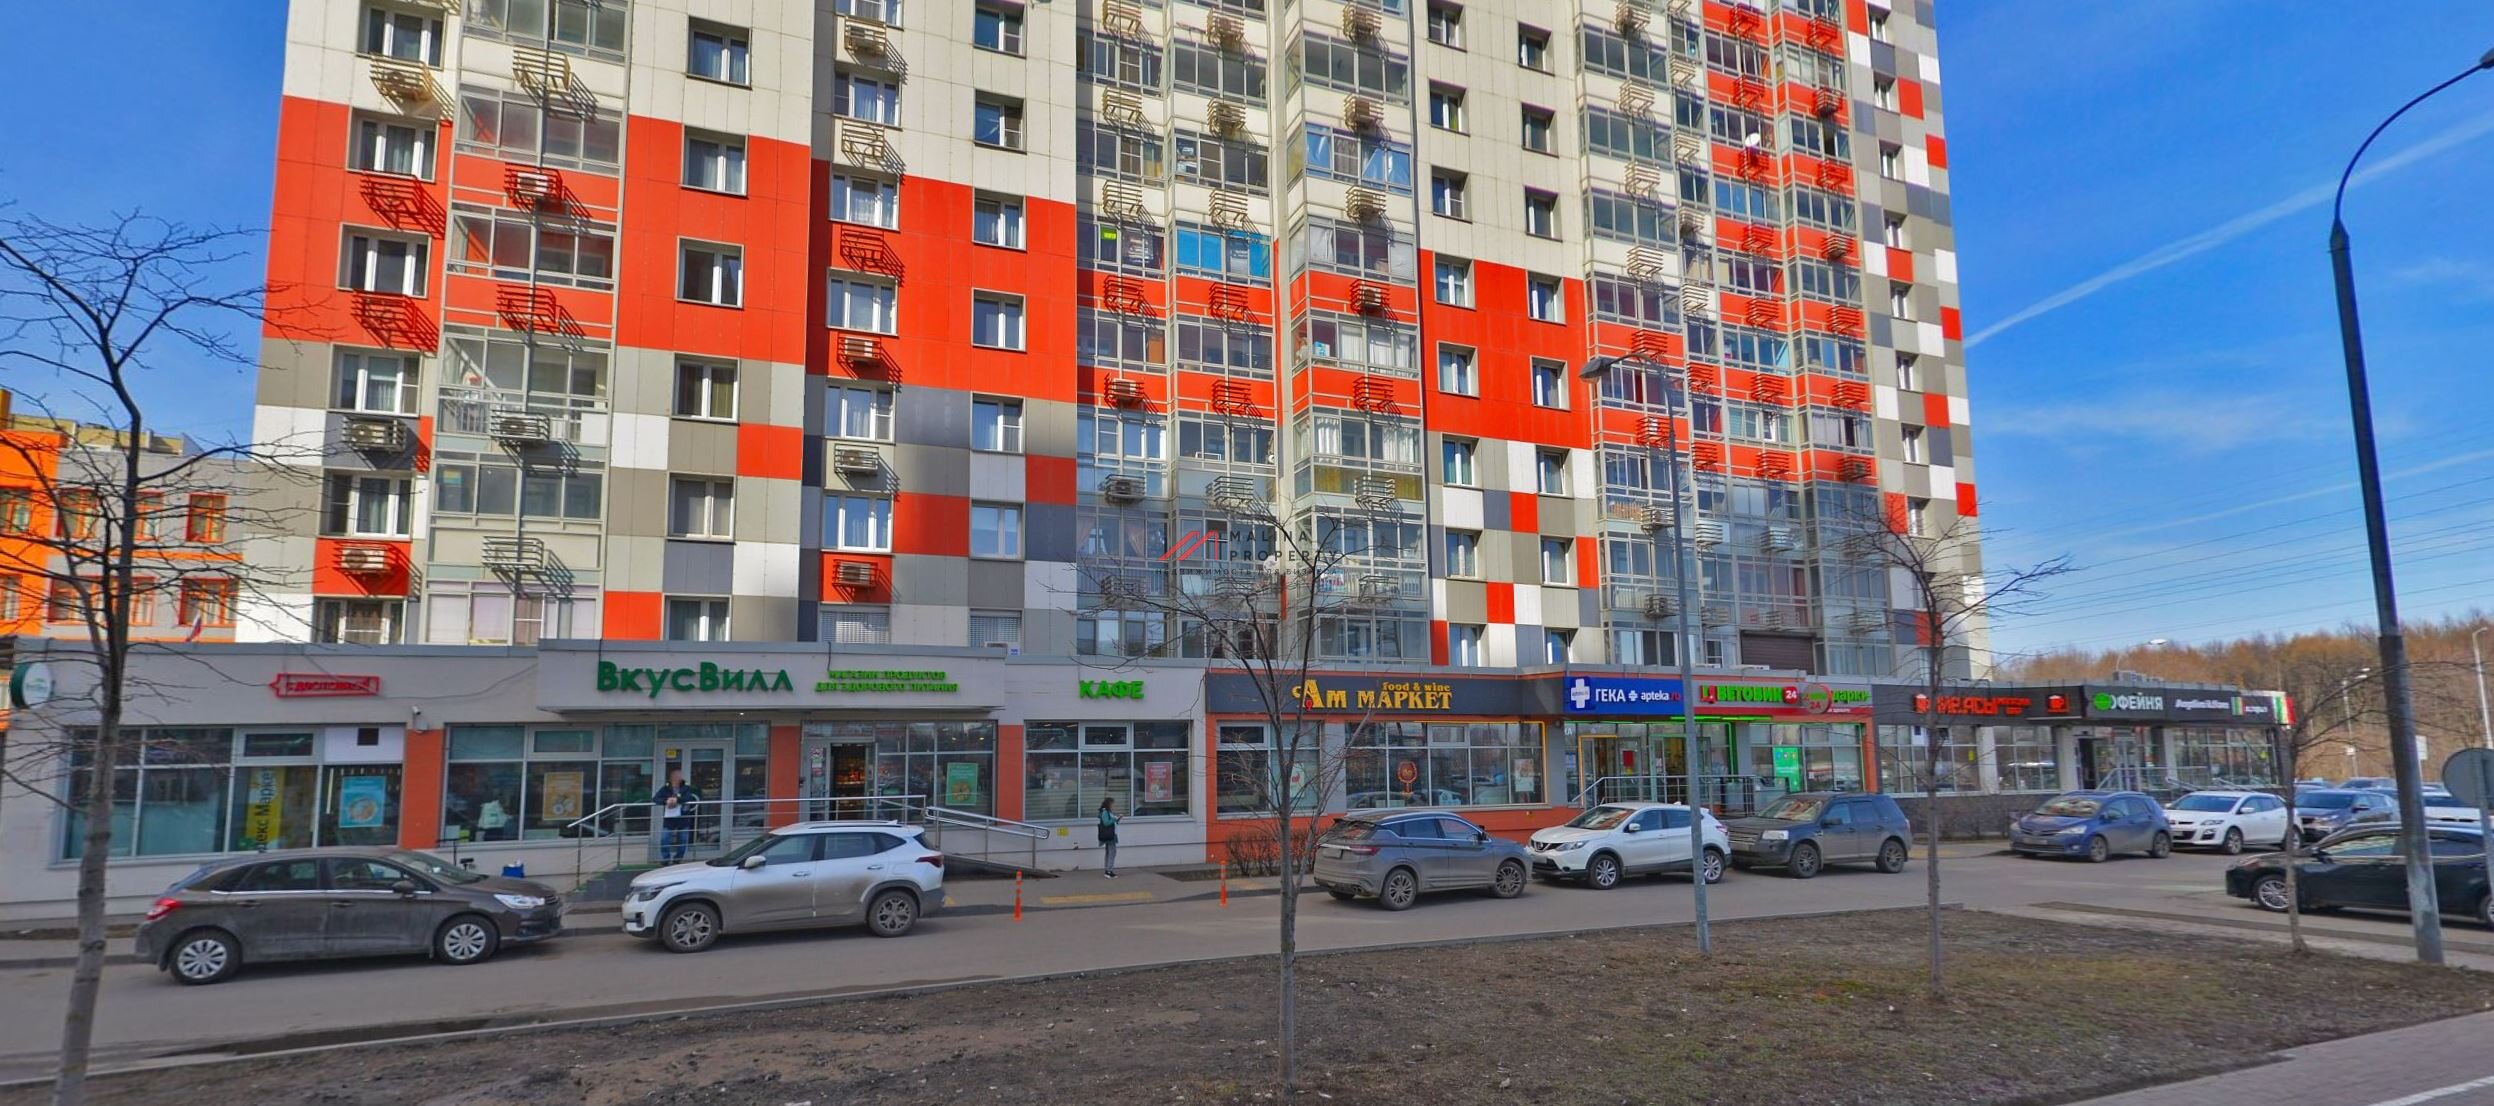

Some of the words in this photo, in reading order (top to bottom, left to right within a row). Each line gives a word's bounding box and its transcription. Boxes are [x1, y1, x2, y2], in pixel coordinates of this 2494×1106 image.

[597, 661, 794, 698] ВкусВилл
[1382, 681, 1409, 691] food
[1413, 682, 1420, 691] &
[1424, 682, 1450, 691] wine
[1079, 680, 1144, 699] КАФЕ
[1785, 690, 1797, 700] 24
